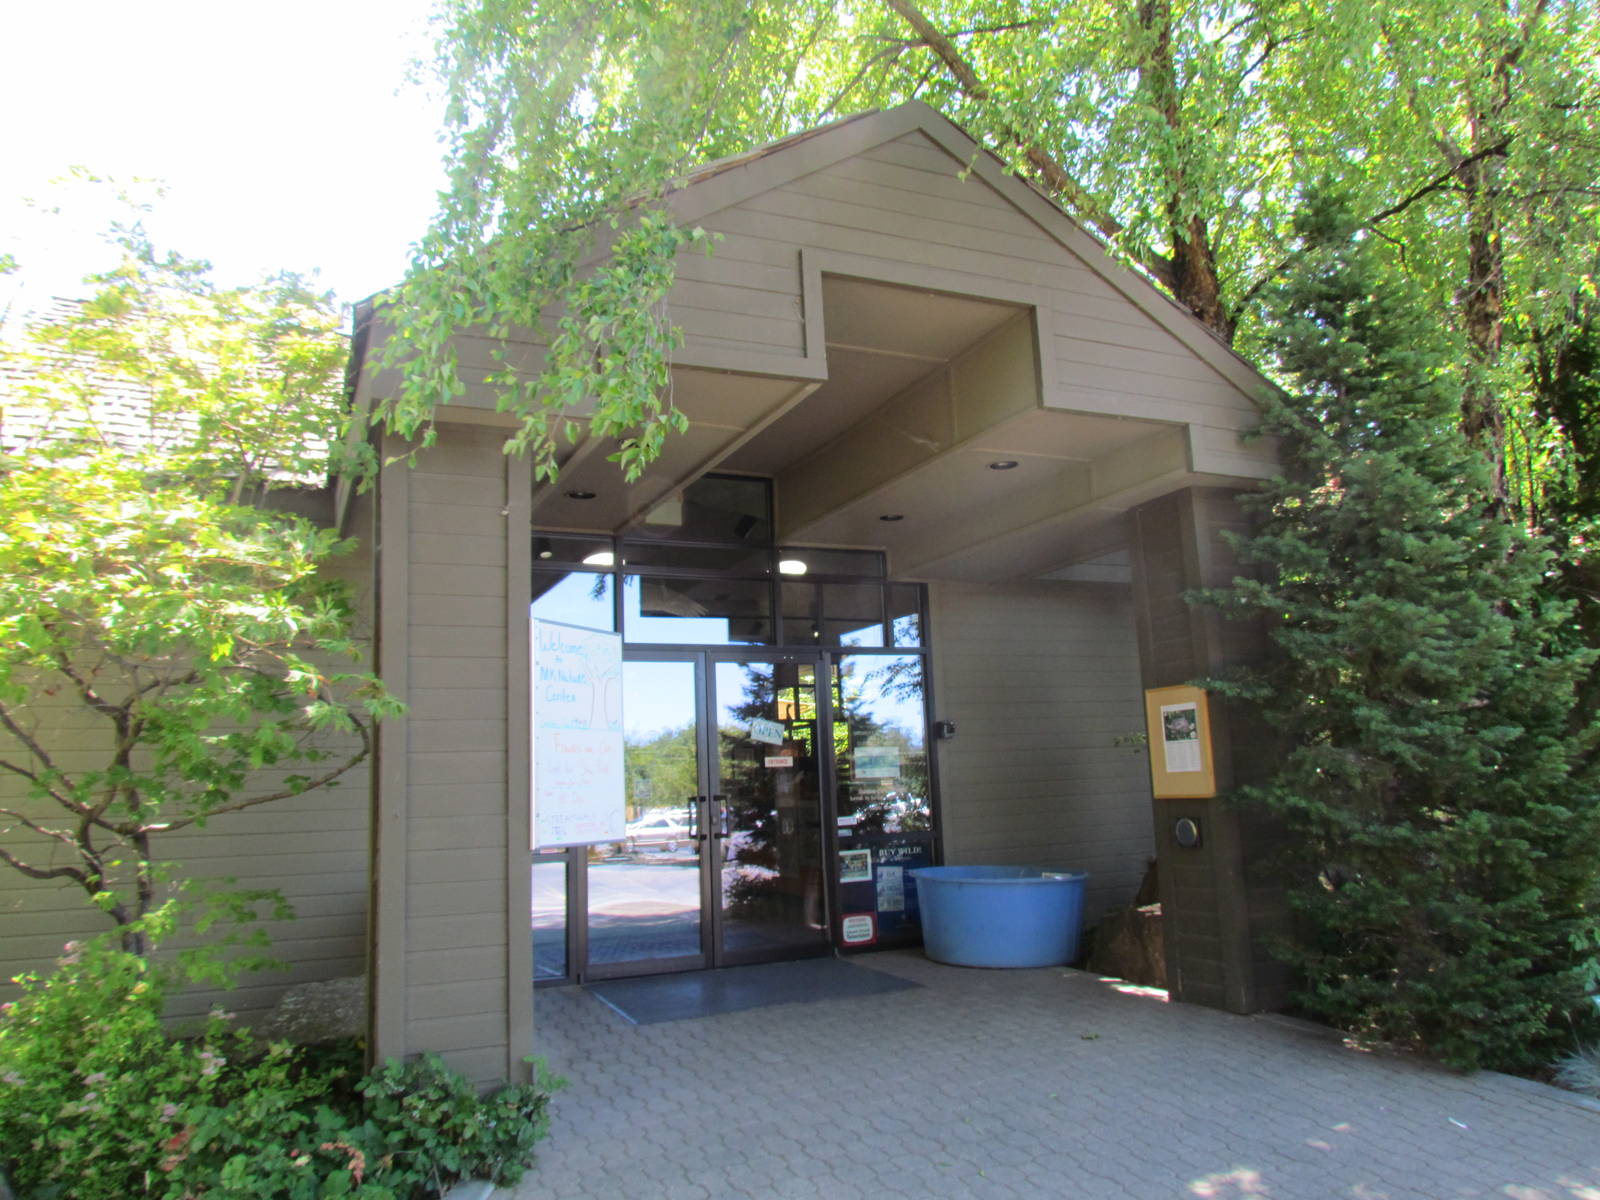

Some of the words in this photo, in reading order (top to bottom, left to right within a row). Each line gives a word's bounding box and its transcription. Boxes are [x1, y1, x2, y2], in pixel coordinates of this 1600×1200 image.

[539, 631, 584, 655] Welcome
[753, 726, 783, 739] OPEN
[879, 848, 897, 857] BUY
